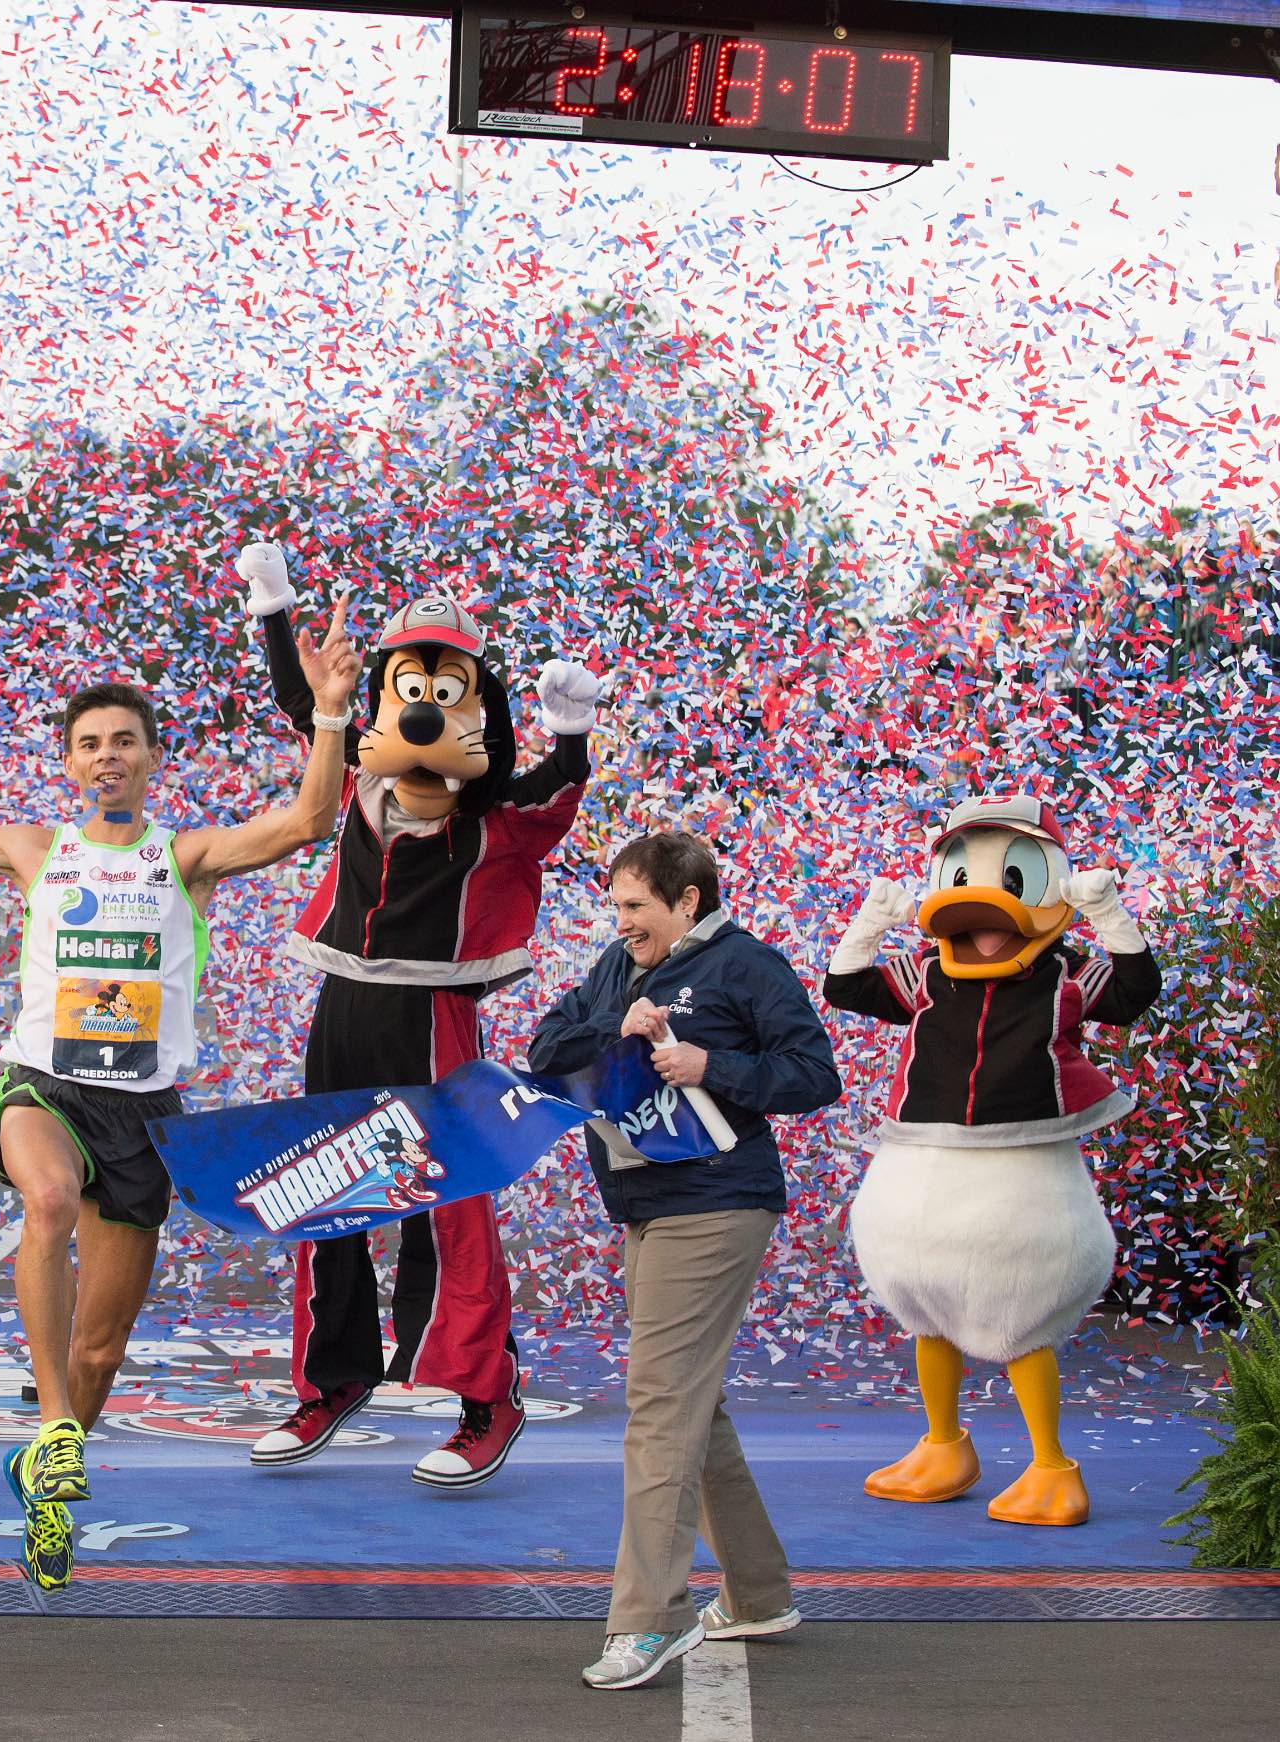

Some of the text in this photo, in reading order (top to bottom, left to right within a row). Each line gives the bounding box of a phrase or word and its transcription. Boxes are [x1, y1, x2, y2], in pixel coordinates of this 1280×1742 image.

[102, 893, 160, 905] NATURAL
[102, 905, 160, 915] ENERGIA
[59, 936, 139, 960] Heliar
[668, 1003, 693, 1015] Cigna
[99, 1046, 114, 1067] 1
[72, 1068, 139, 1079] FREDISON
[373, 1089, 392, 1106] 2015
[235, 1123, 336, 1193] WALT DISNEY WORLD
[238, 1099, 425, 1233] MARATHON
